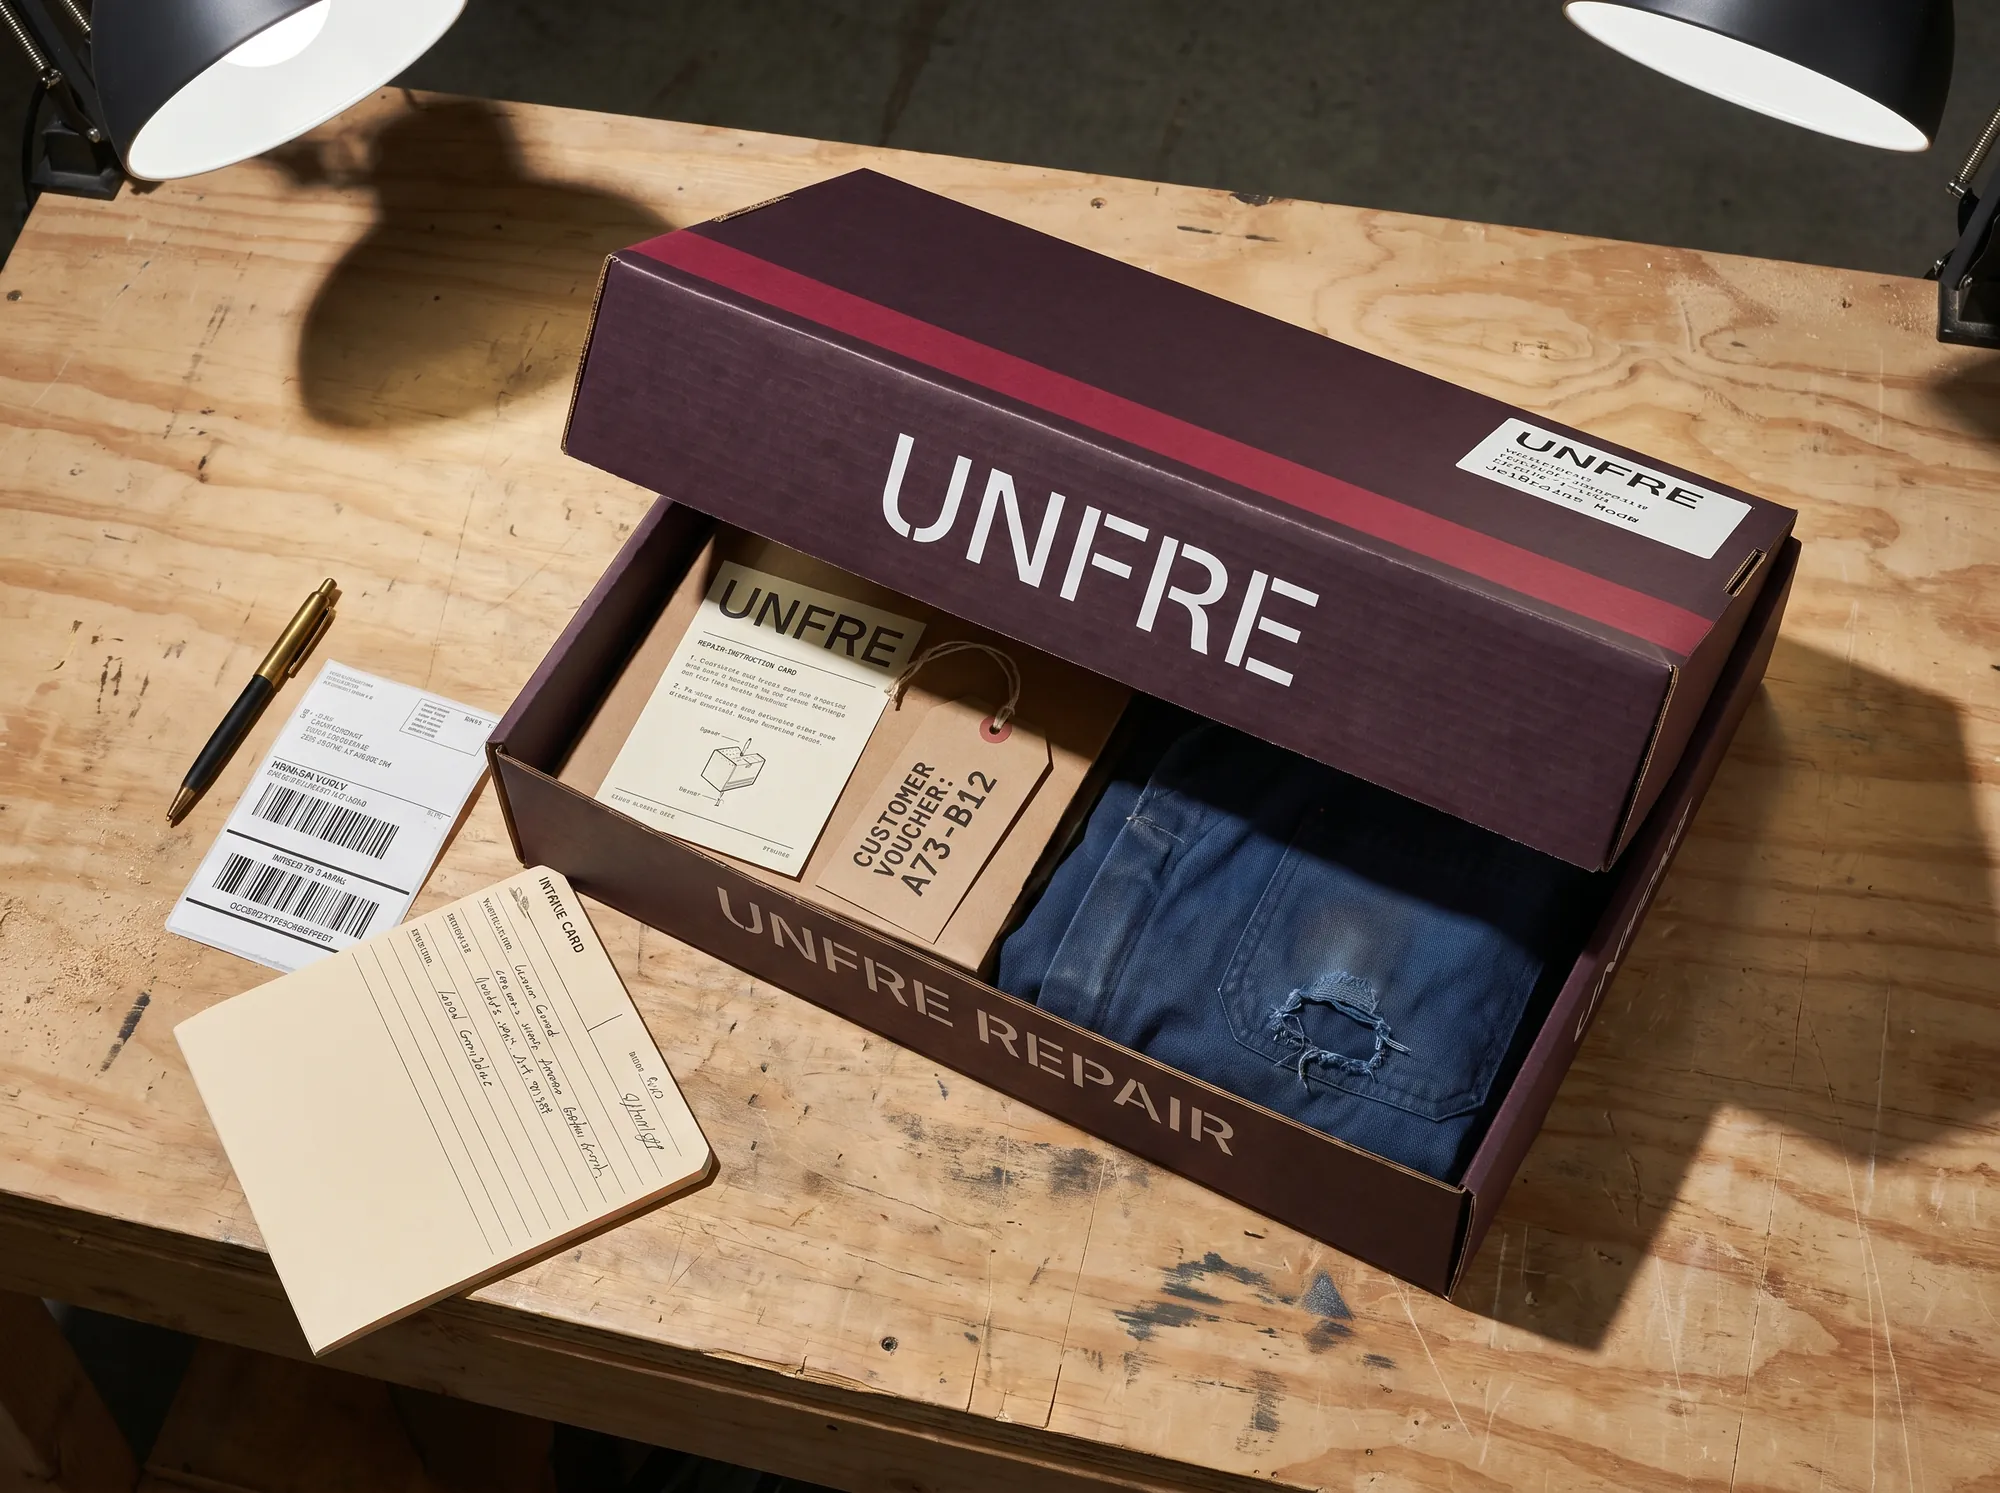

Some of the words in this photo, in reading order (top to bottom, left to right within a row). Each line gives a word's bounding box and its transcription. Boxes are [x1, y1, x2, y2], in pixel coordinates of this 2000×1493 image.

[1516, 431, 1704, 510] UNFRE
[882, 432, 1319, 688] UNFRE
[718, 579, 905, 668] UNFRE
[777, 665, 797, 676] CARD
[853, 762, 935, 867] CUSTOMER
[873, 777, 954, 877] VOUCHER:
[901, 770, 998, 897] A73-B12
[561, 921, 585, 954] CARD
[716, 885, 954, 1028] UNFRE
[976, 1007, 1235, 1158] REPAIR
